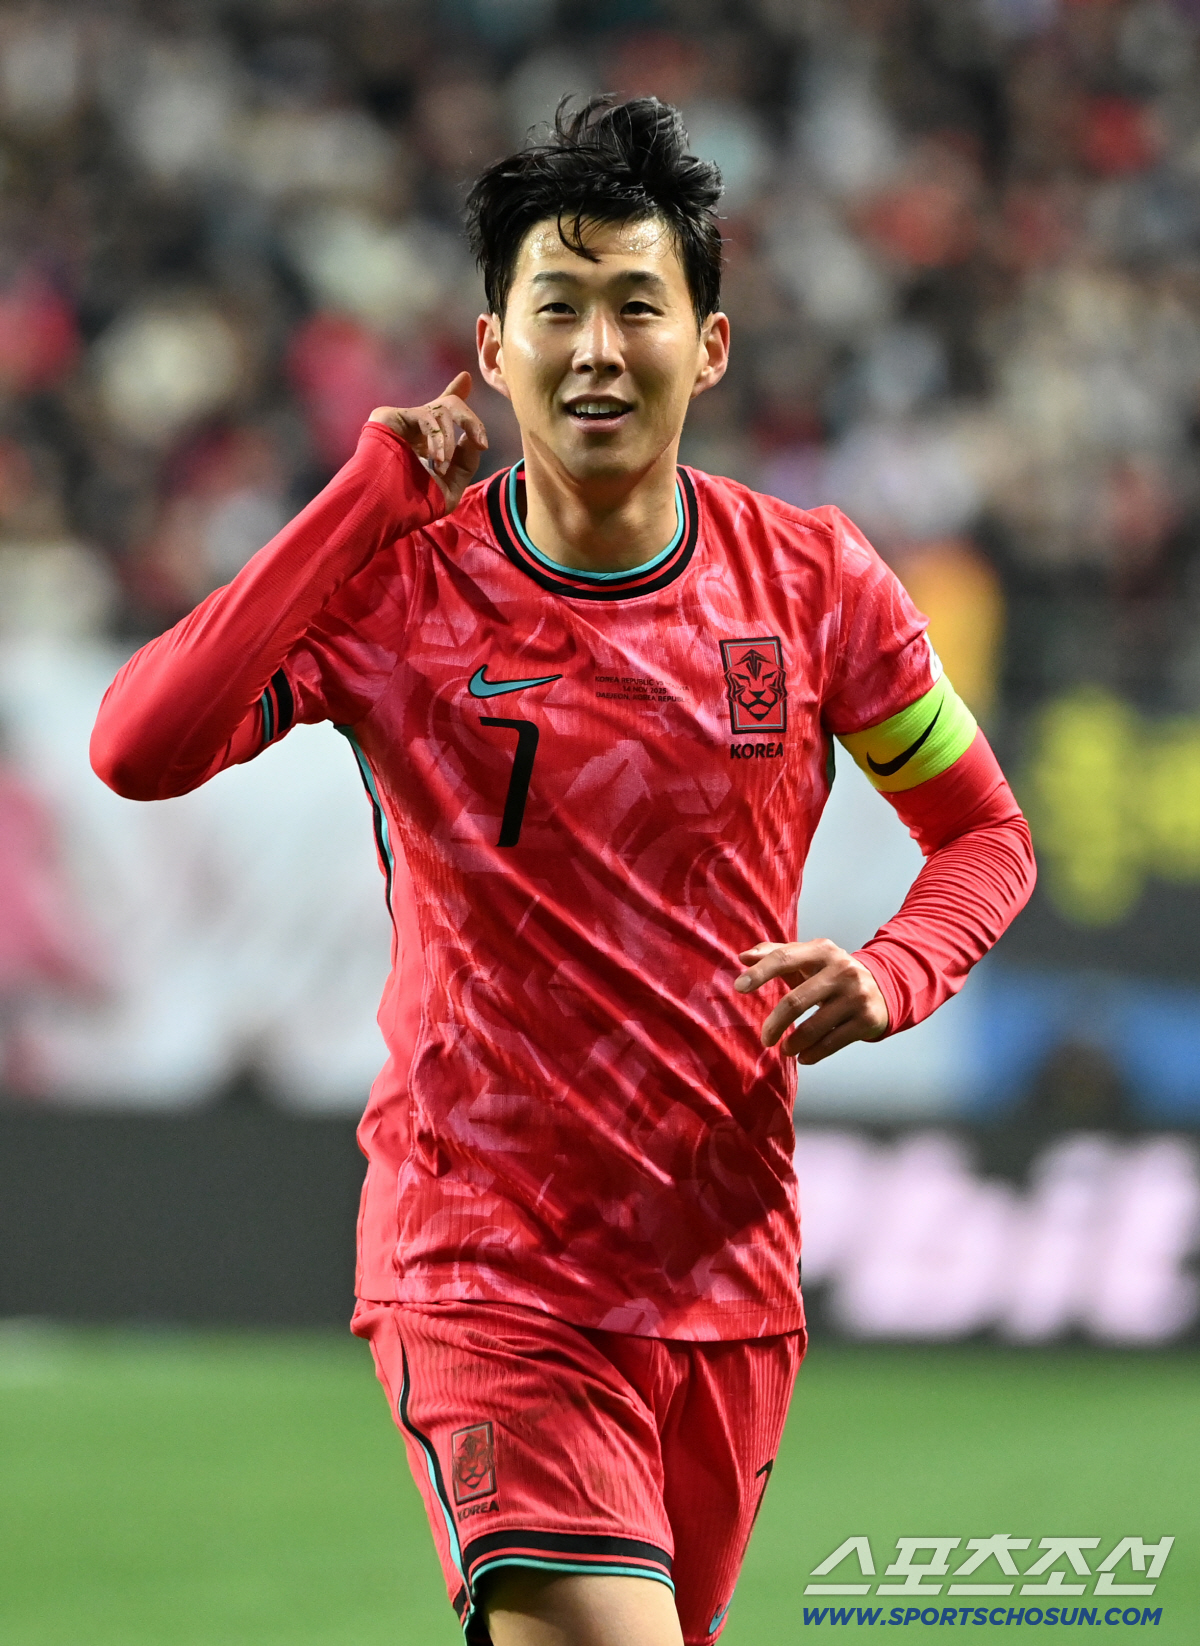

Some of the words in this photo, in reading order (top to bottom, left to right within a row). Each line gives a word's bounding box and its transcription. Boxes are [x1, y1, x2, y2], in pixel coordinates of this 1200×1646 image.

[621, 677, 654, 686] REPUBLIC
[633, 694, 656, 702] KOREA
[730, 742, 784, 759] KOREA
[479, 716, 539, 847] 7
